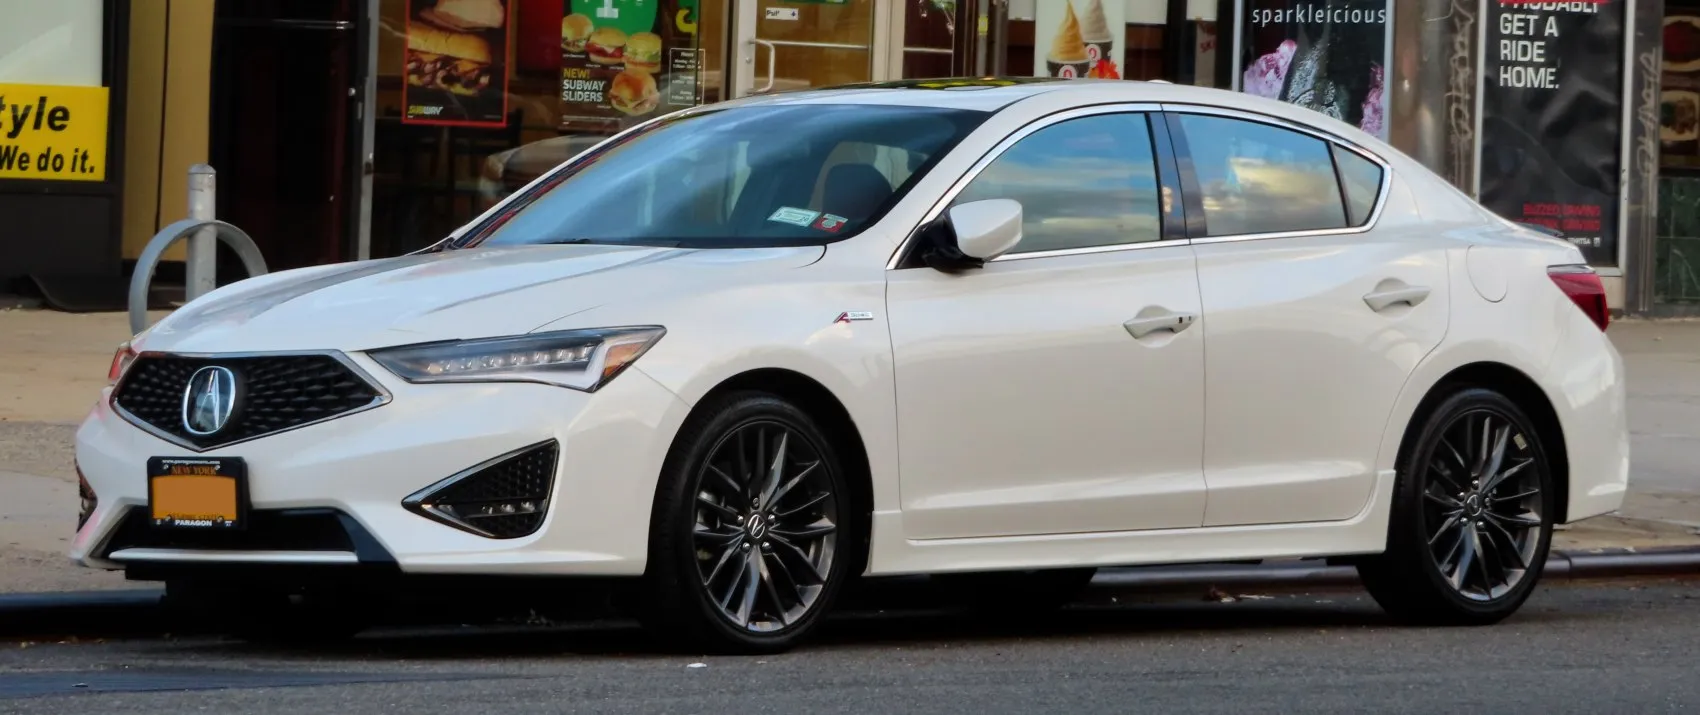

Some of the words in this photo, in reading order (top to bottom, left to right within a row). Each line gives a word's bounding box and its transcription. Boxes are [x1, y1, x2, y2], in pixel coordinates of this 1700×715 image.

[1252, 4, 1386, 28] sparkleicious
[1500, 13, 1539, 36] GET
[1544, 16, 1559, 37] A
[1500, 39, 1546, 62] RIDE
[563, 79, 605, 91] SUBWAY
[1500, 66, 1560, 89] HOME.
[562, 91, 604, 102] SLIDERS
[0, 145, 30, 171] We
[37, 146, 65, 172] do
[71, 147, 96, 174] it.
[175, 519, 213, 527] PARAGON
